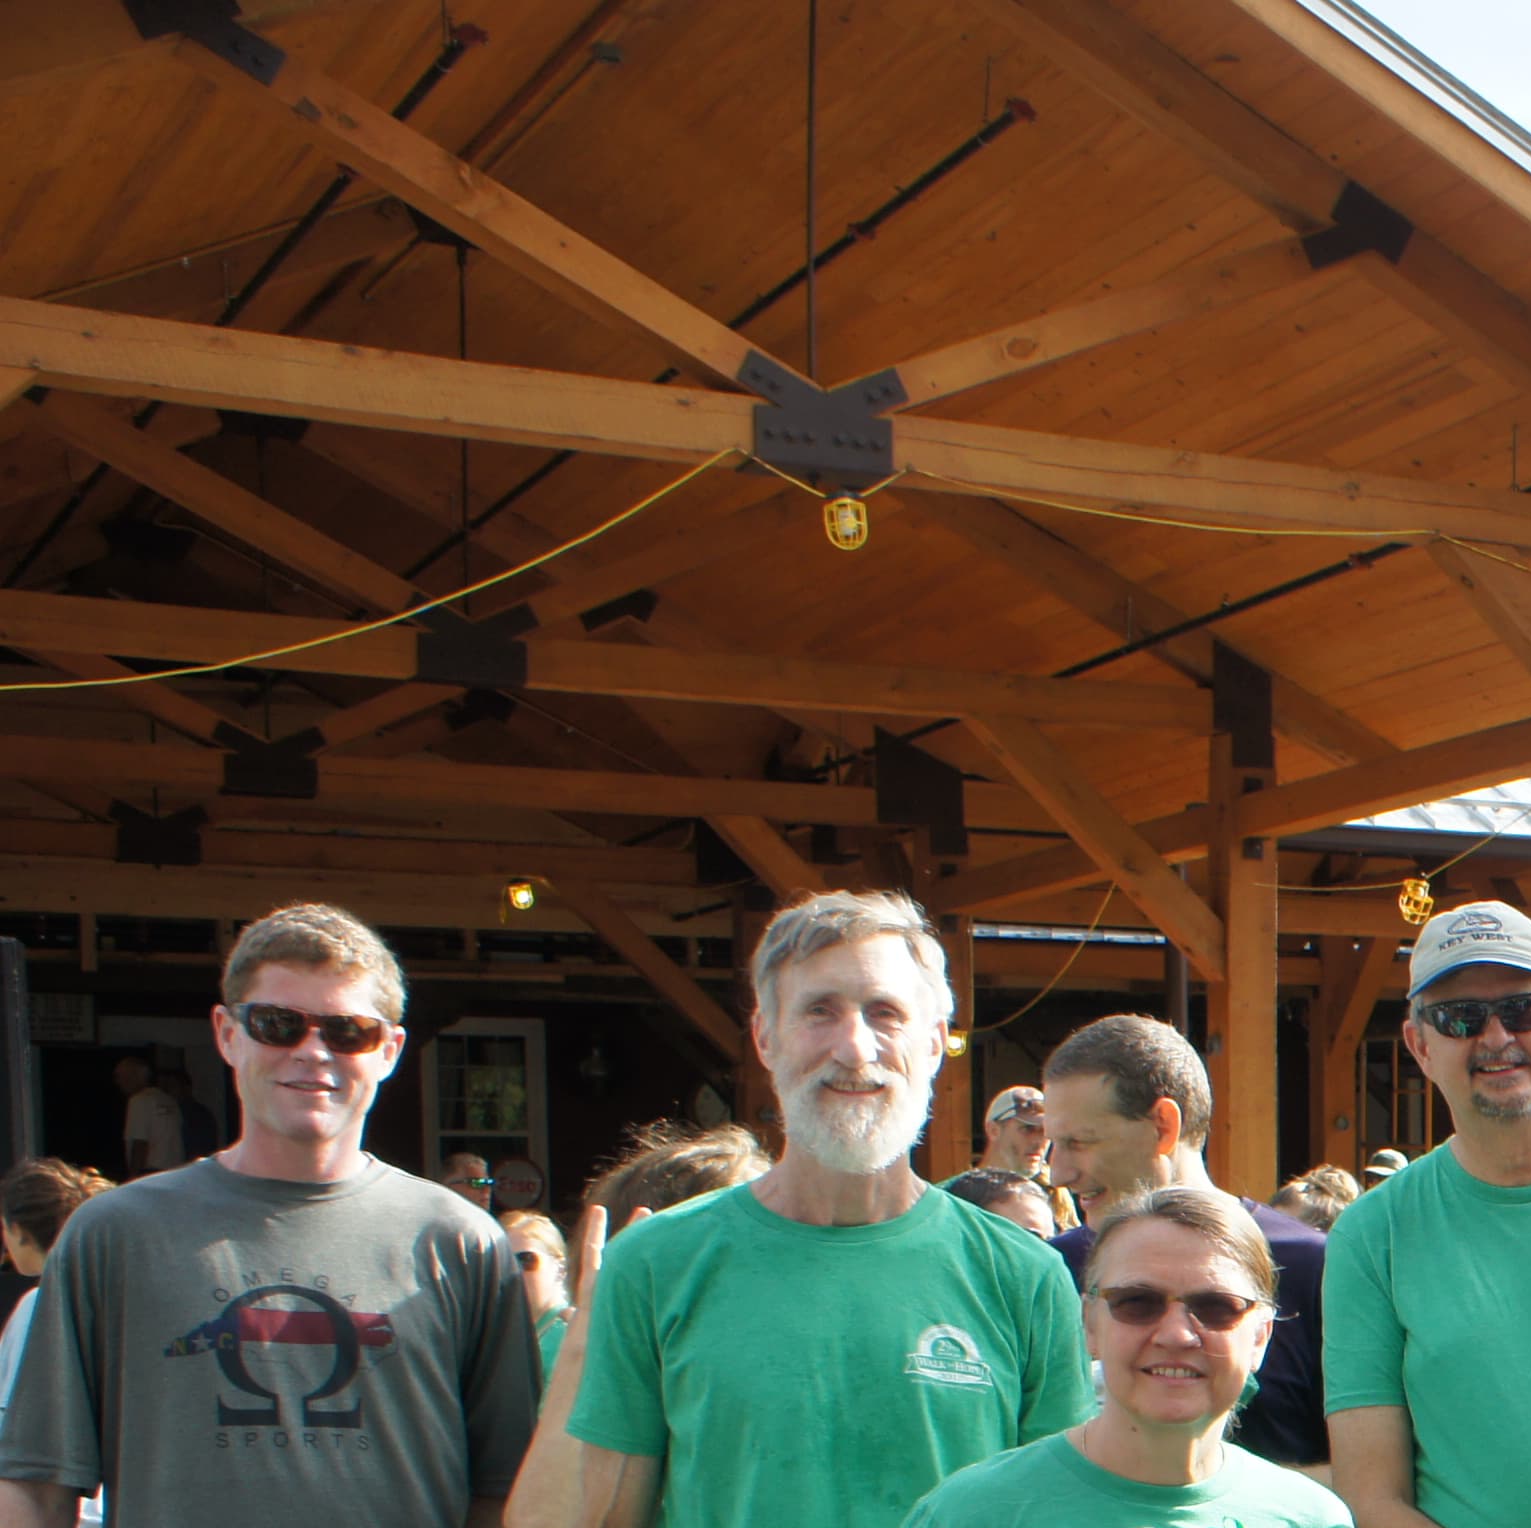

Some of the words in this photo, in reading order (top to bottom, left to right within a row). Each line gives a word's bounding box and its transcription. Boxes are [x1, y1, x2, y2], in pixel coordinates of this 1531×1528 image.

[1438, 935, 1466, 951] KEY
[1471, 932, 1513, 943] WEST
[213, 1266, 358, 1306] OMEGA
[215, 1432, 370, 1450] SPORTS
